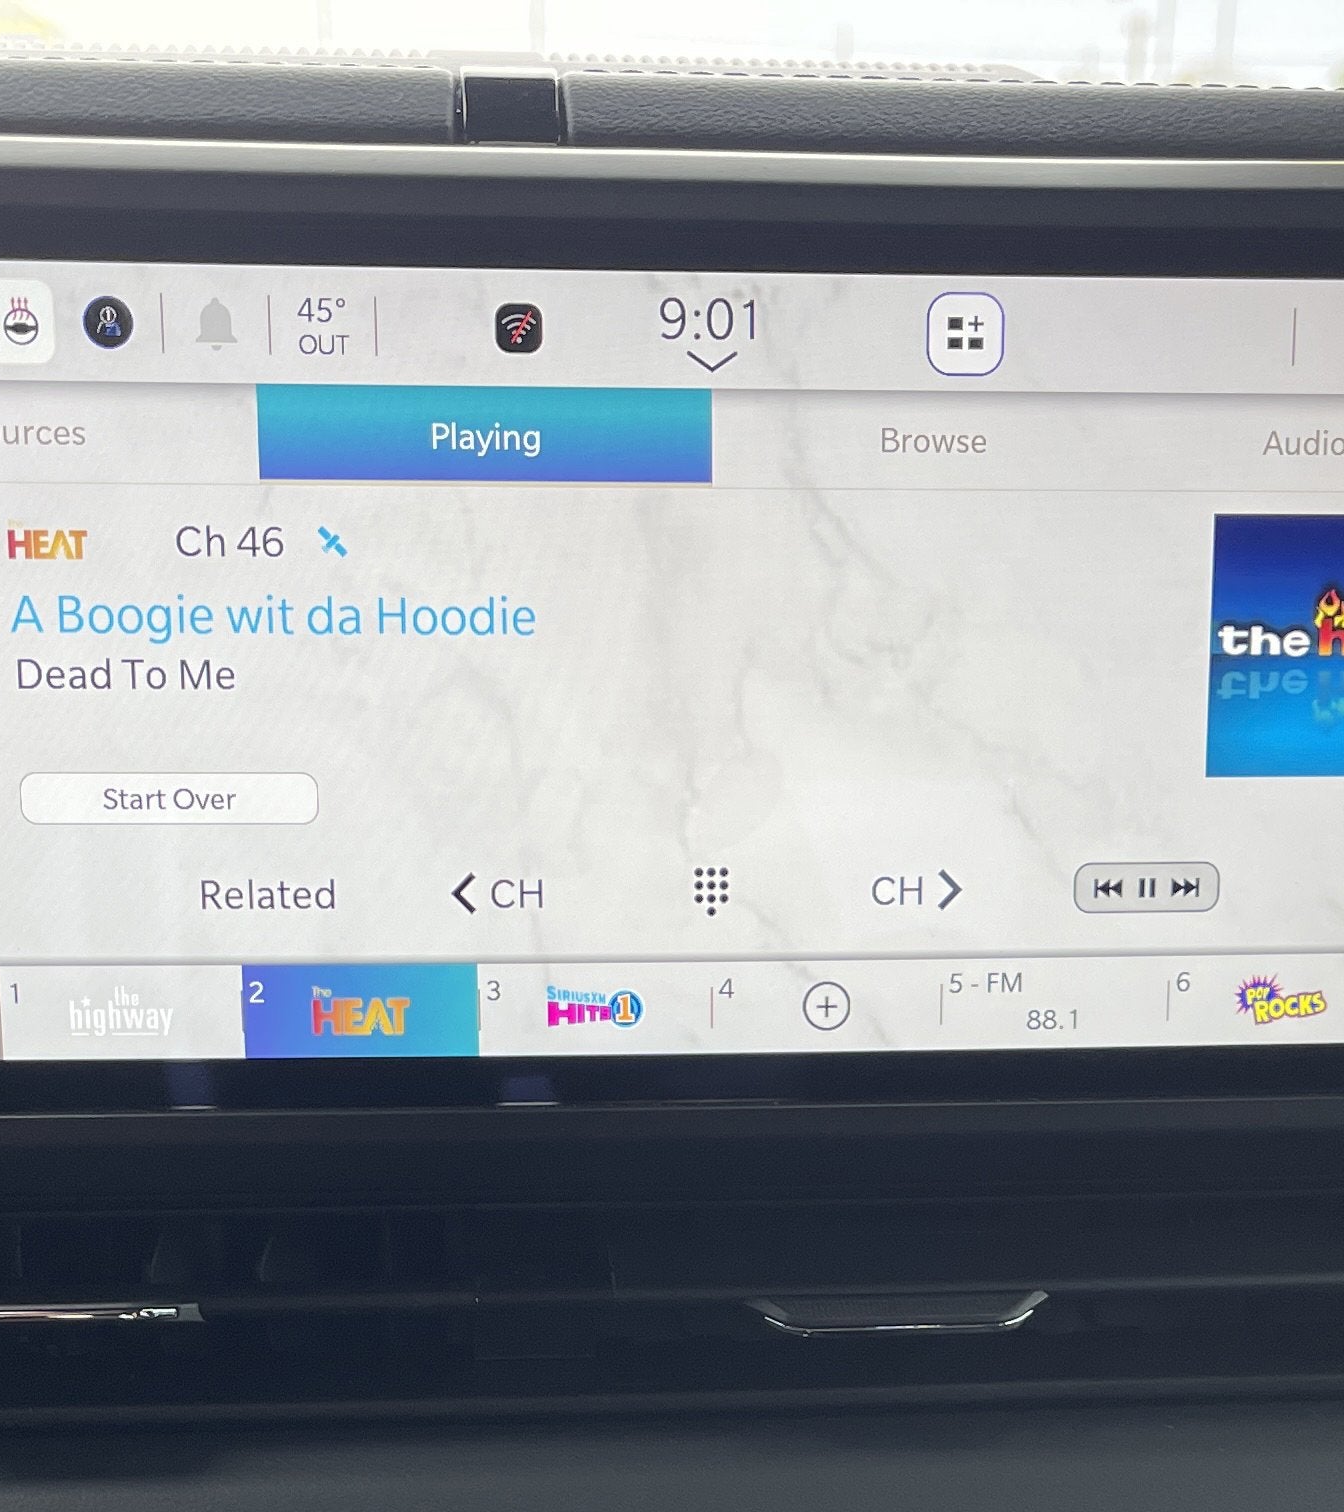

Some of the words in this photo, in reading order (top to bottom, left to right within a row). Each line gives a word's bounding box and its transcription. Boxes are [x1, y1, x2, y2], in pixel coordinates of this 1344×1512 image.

[297, 297, 346, 323] 45°
[659, 298, 761, 341] 9:01
[299, 334, 350, 356] OUT
[429, 421, 542, 458] Playing
[880, 425, 988, 456] Browse
[6, 529, 88, 560] HEAT
[176, 525, 226, 558] Ch
[237, 526, 285, 558] 46
[10, 594, 45, 635] A
[58, 593, 214, 645] Boogie
[226, 594, 295, 635] wit
[307, 596, 362, 636] da
[378, 596, 537, 637] Hoodie
[1217, 625, 1312, 657] the
[16, 658, 112, 690] Dead
[121, 659, 167, 690] To
[179, 659, 236, 690] Me
[102, 787, 166, 812] Start
[172, 787, 237, 813] Over
[200, 878, 338, 912] Related
[490, 880, 546, 912] CH
[870, 875, 926, 907] CH
[9, 982, 21, 1004] 1
[114, 985, 140, 1007] the
[248, 981, 266, 1004] 2
[486, 980, 501, 1001] 3
[718, 977, 736, 999] 4
[948, 972, 964, 994] 5
[987, 972, 1023, 993] FM
[1175, 971, 1192, 993] 6
[69, 997, 175, 1036] highway
[311, 997, 411, 1035] HEAT
[1026, 1008, 1080, 1031] 88.1
[1253, 990, 1326, 1025] ROCKS
